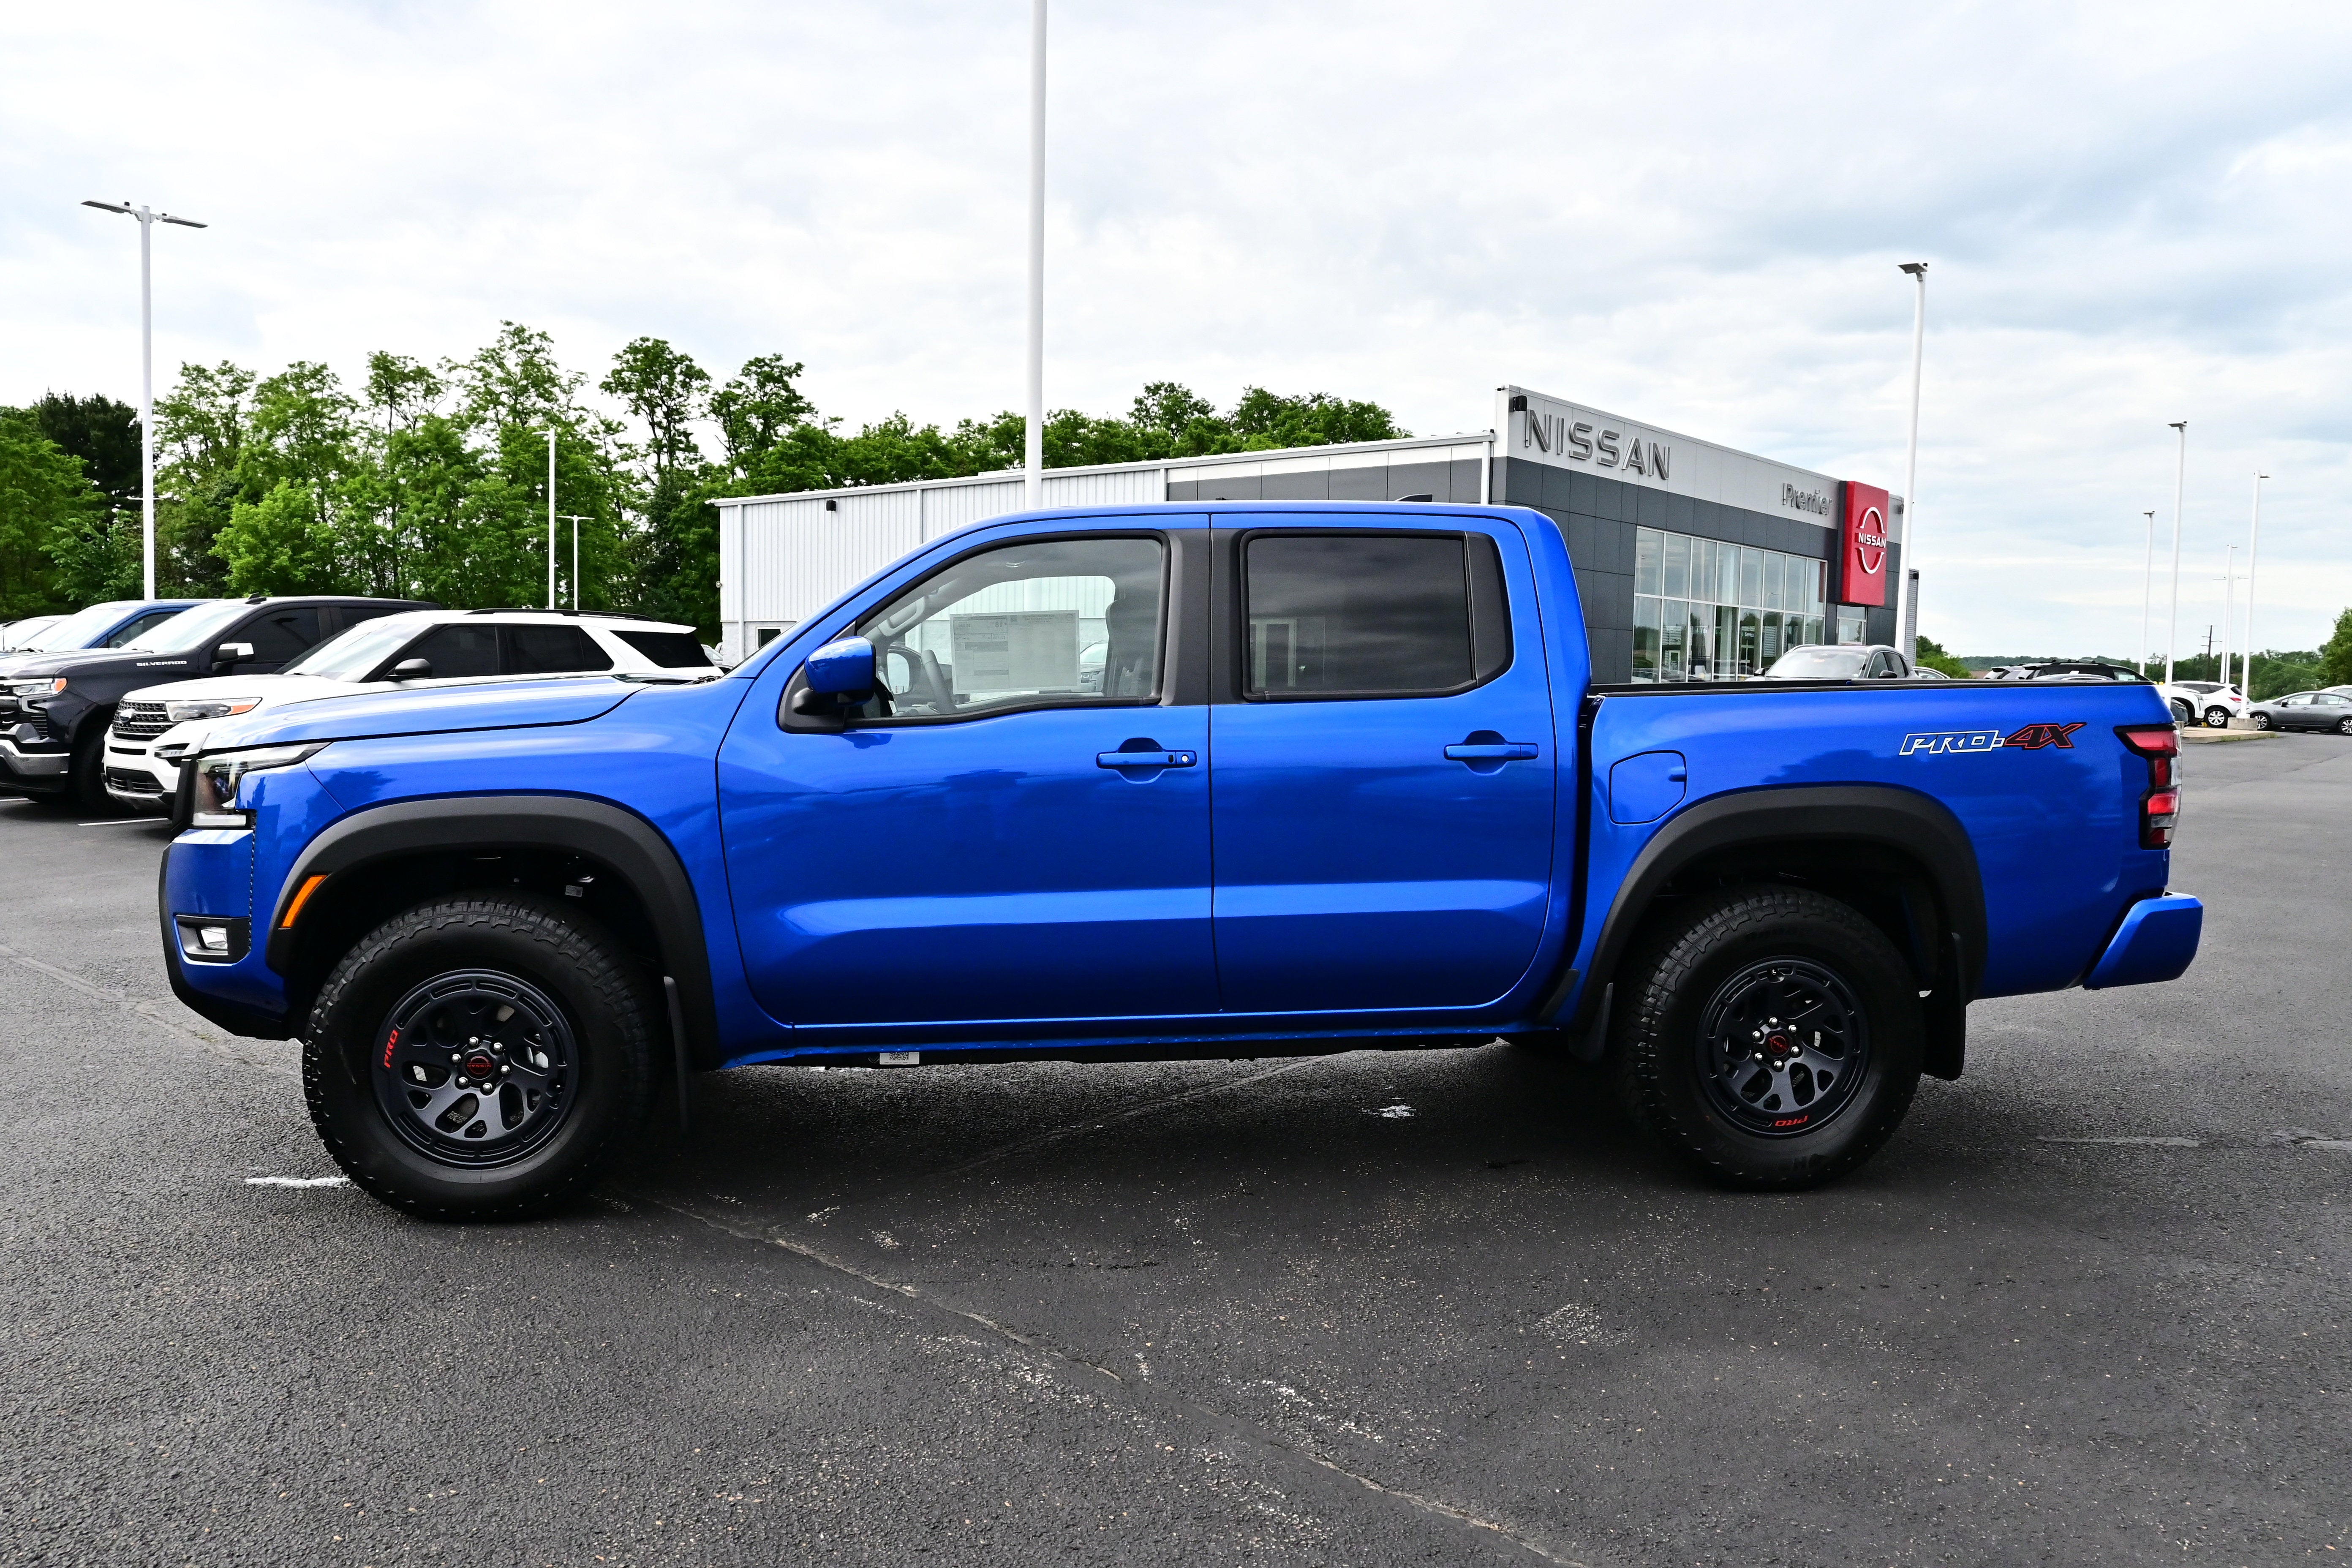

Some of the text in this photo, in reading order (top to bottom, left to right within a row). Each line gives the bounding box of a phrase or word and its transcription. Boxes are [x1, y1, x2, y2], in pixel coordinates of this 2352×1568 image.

[1525, 408, 1671, 480] NISSAN
[1782, 482, 1833, 515] Premier
[1858, 532, 1886, 548] NISSAN
[384, 1029, 398, 1068] PRO
[1775, 1115, 1808, 1126] PRO
